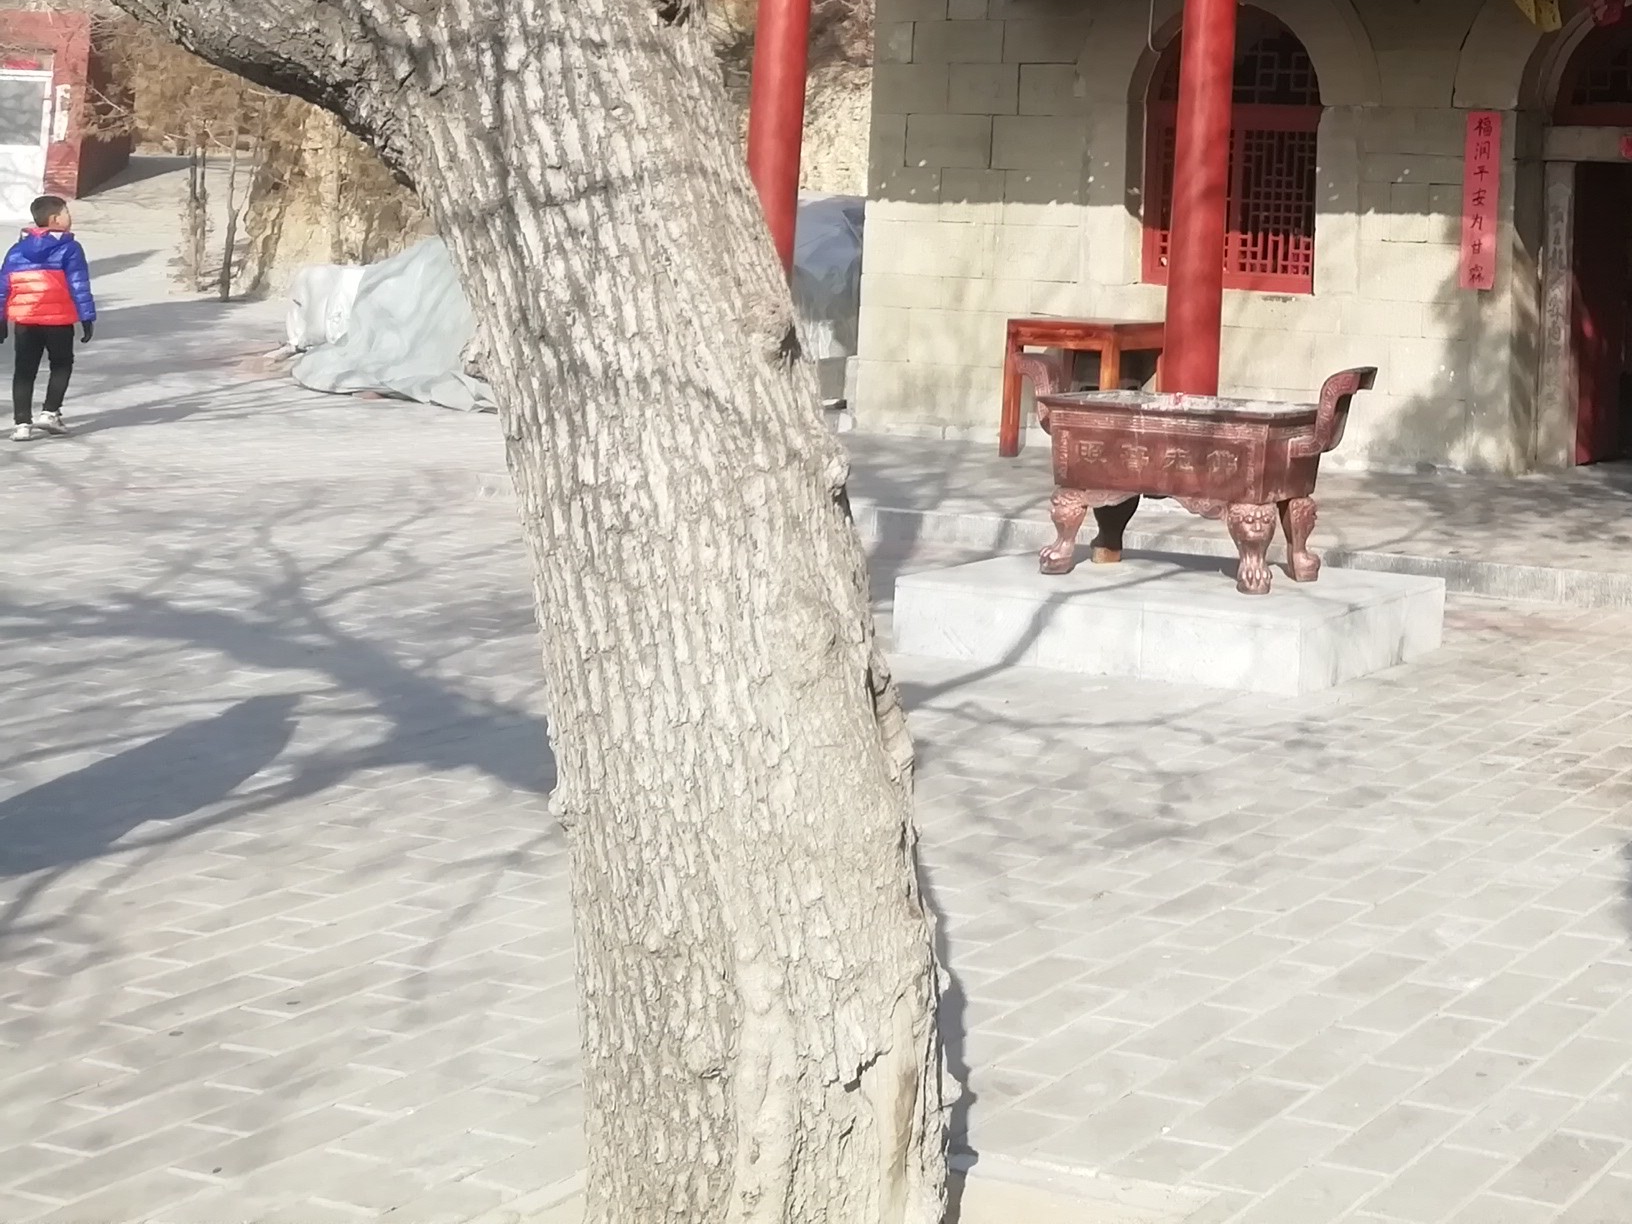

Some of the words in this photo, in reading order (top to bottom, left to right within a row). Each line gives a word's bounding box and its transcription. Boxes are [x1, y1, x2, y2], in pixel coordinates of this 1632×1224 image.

[1469, 116, 1493, 284] 福润平安为甘霖
